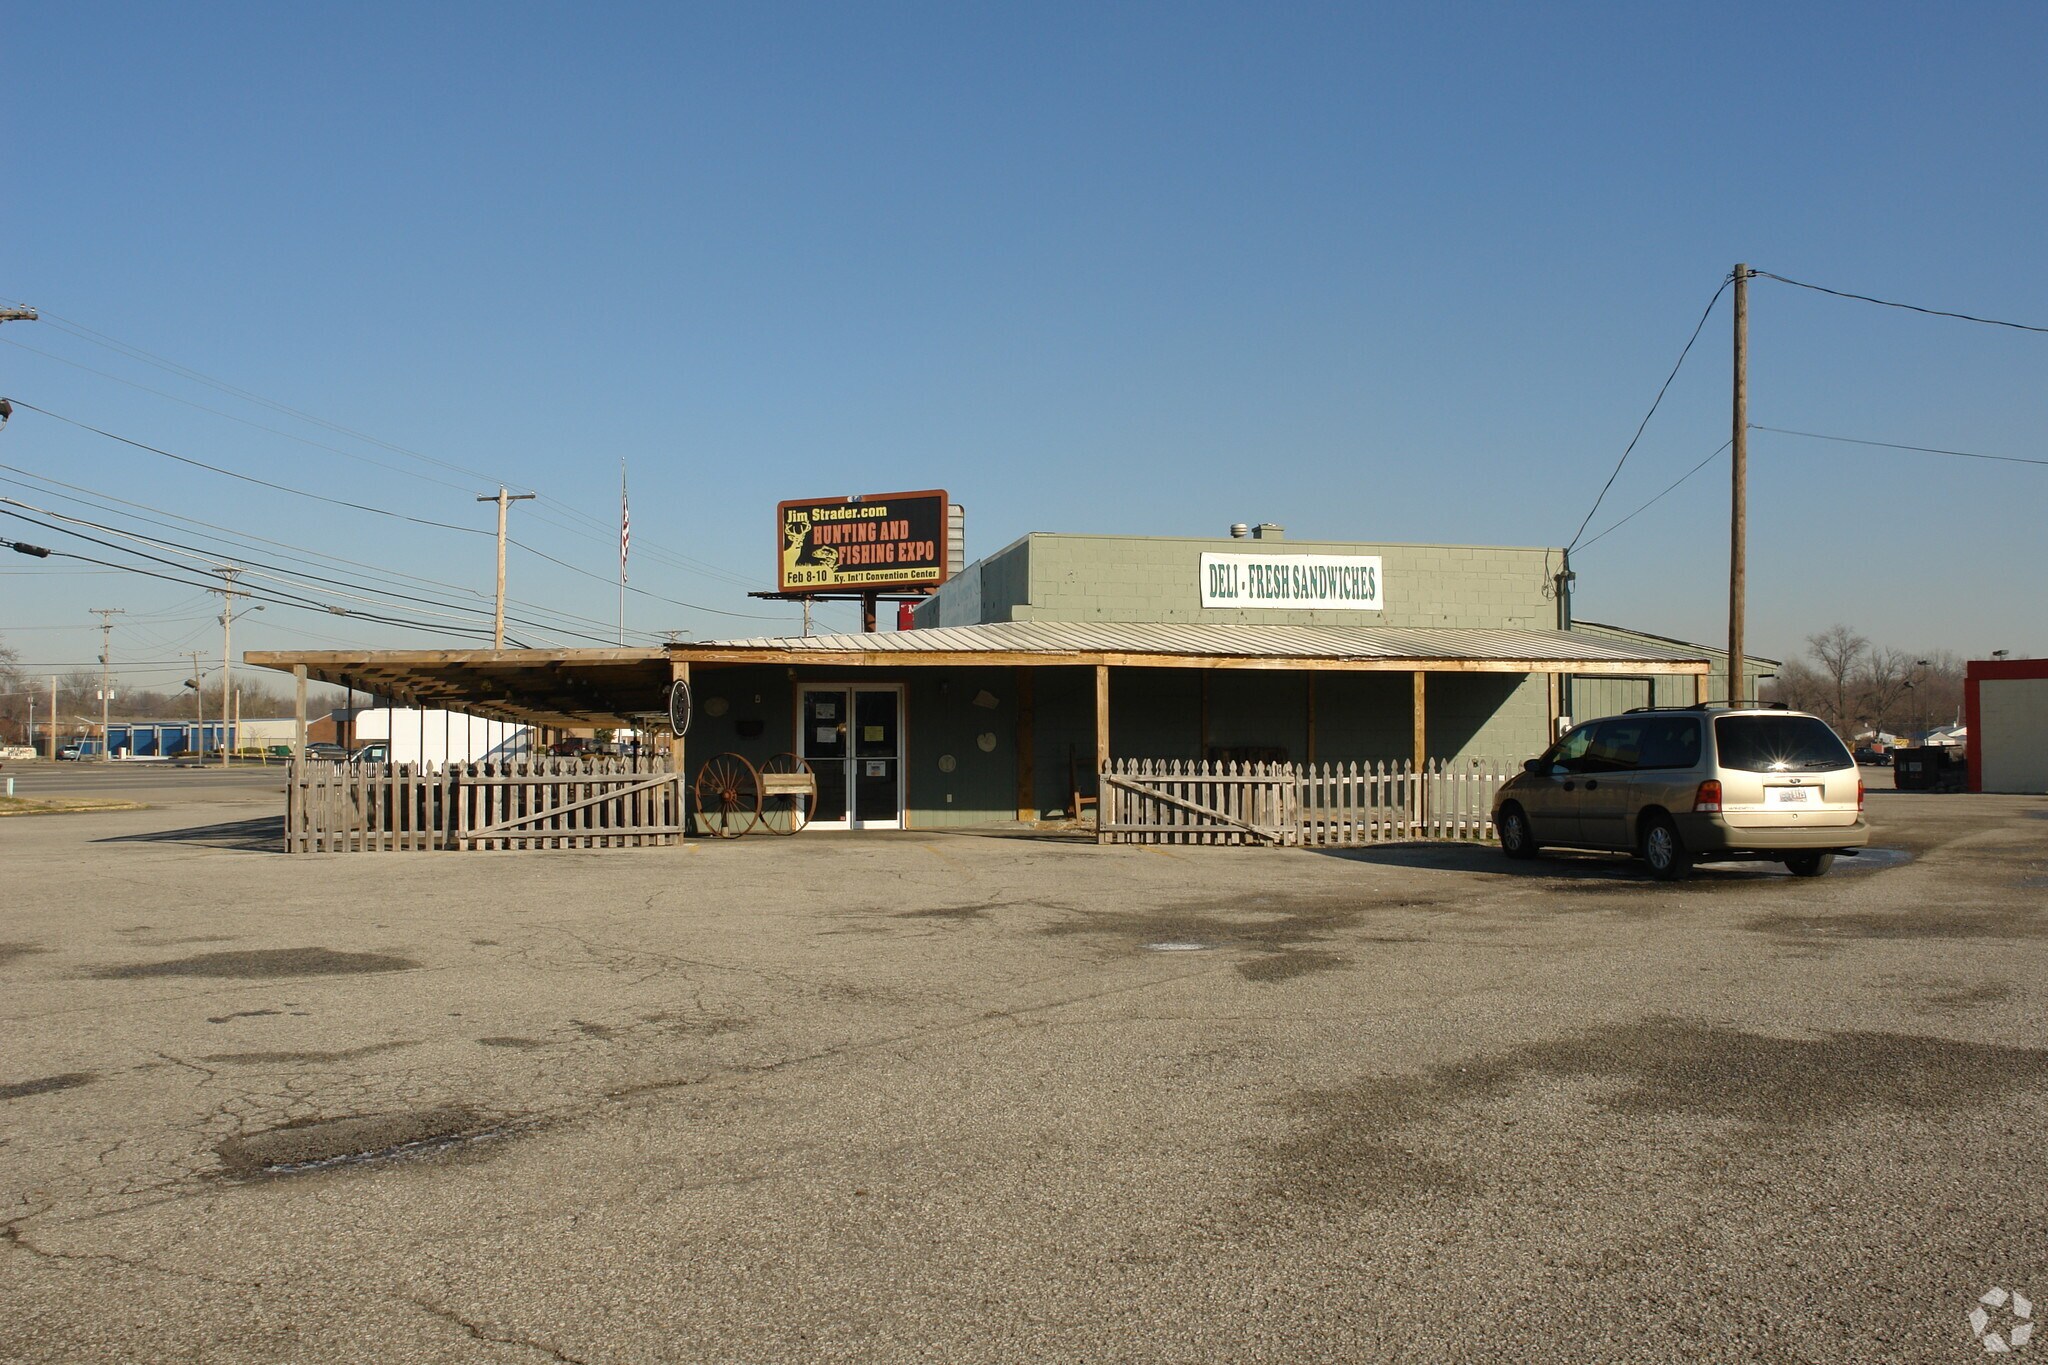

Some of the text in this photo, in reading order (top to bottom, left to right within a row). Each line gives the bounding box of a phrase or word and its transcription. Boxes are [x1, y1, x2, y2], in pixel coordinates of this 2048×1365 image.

[787, 506, 887, 523] Jim Strader.com
[813, 520, 909, 545] HUNTING AND
[838, 540, 934, 565] FISHING EXPO
[787, 570, 827, 584] Feb 8-10
[834, 574, 846, 584] Ky.
[865, 570, 909, 581] Convention
[911, 569, 937, 579] Center
[1209, 563, 1239, 598] DELI
[1248, 564, 1290, 599] FRESH
[1293, 565, 1376, 601] SANDWICHES
